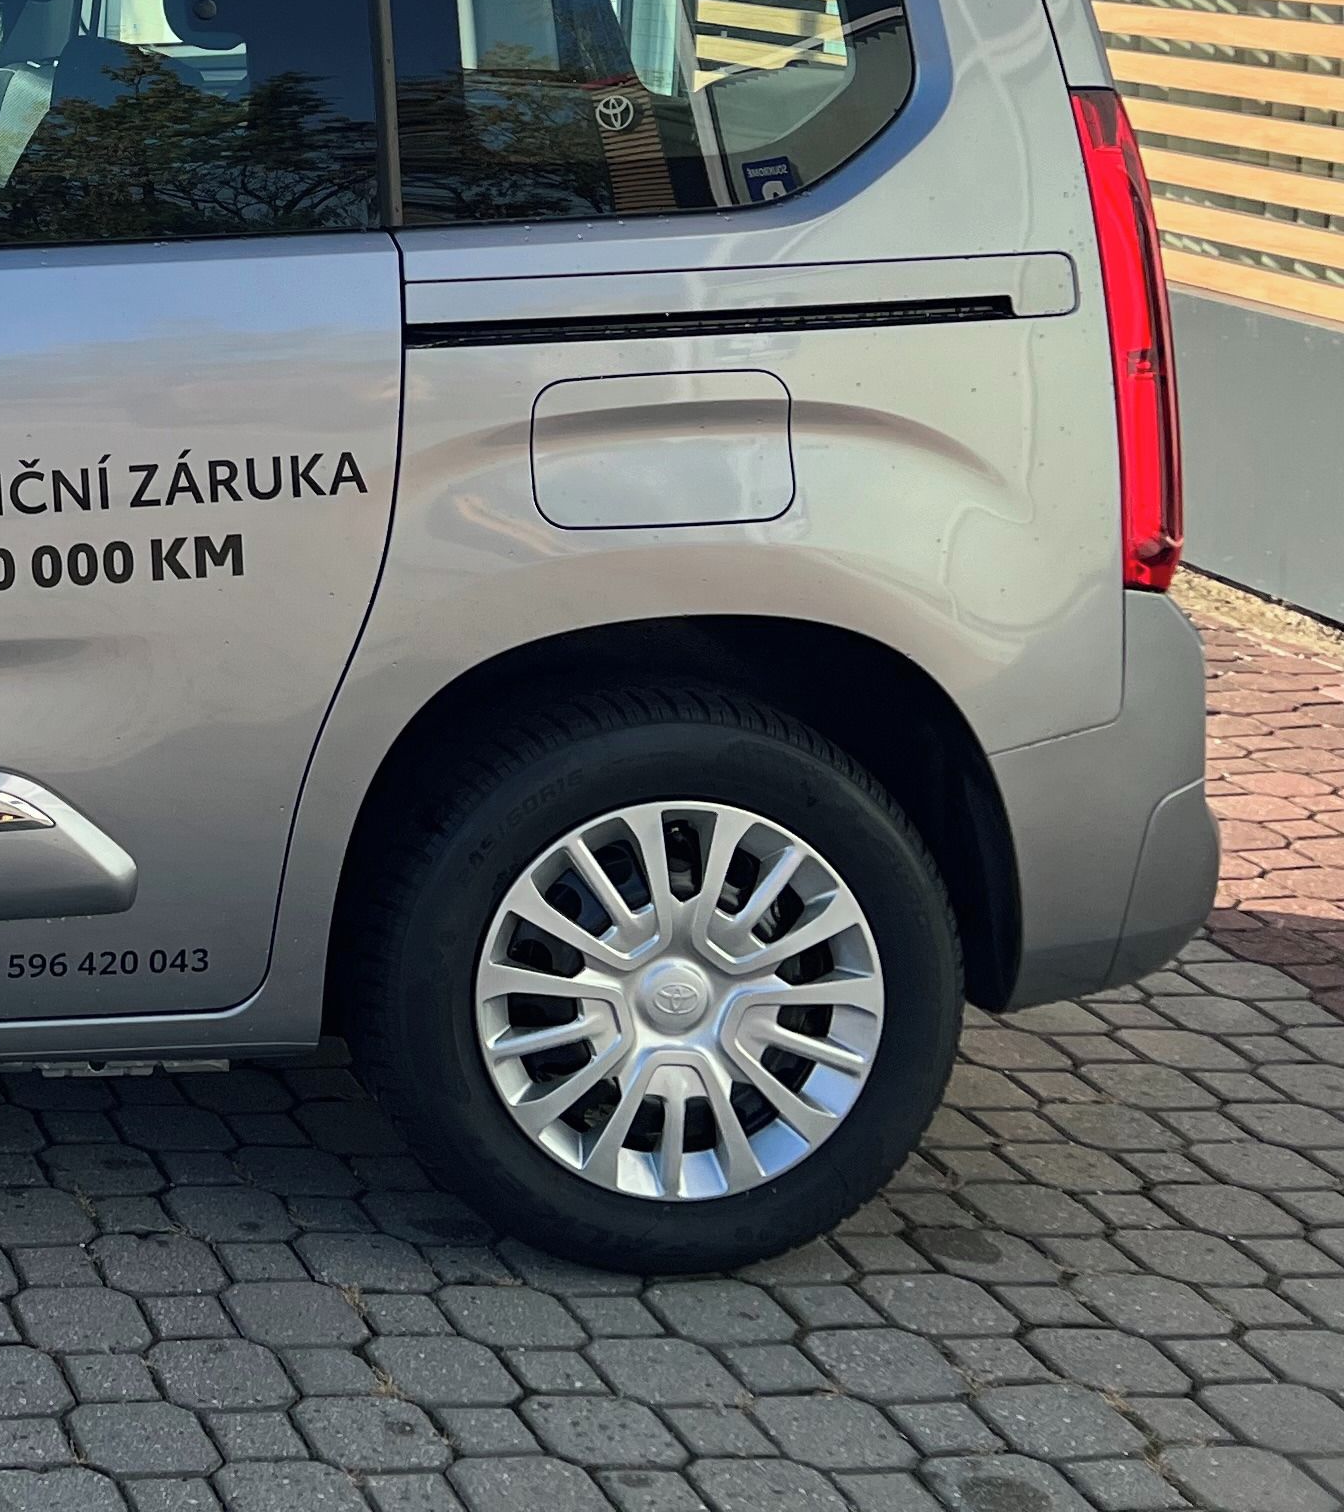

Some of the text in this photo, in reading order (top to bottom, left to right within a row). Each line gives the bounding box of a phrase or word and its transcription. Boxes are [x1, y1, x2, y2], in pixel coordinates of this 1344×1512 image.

[129, 448, 369, 508] ZÁRUKA
[30, 540, 134, 588] 000
[150, 533, 245, 582] KM
[7, 952, 68, 980] 596
[77, 949, 140, 977] 420
[149, 947, 210, 975] 043
